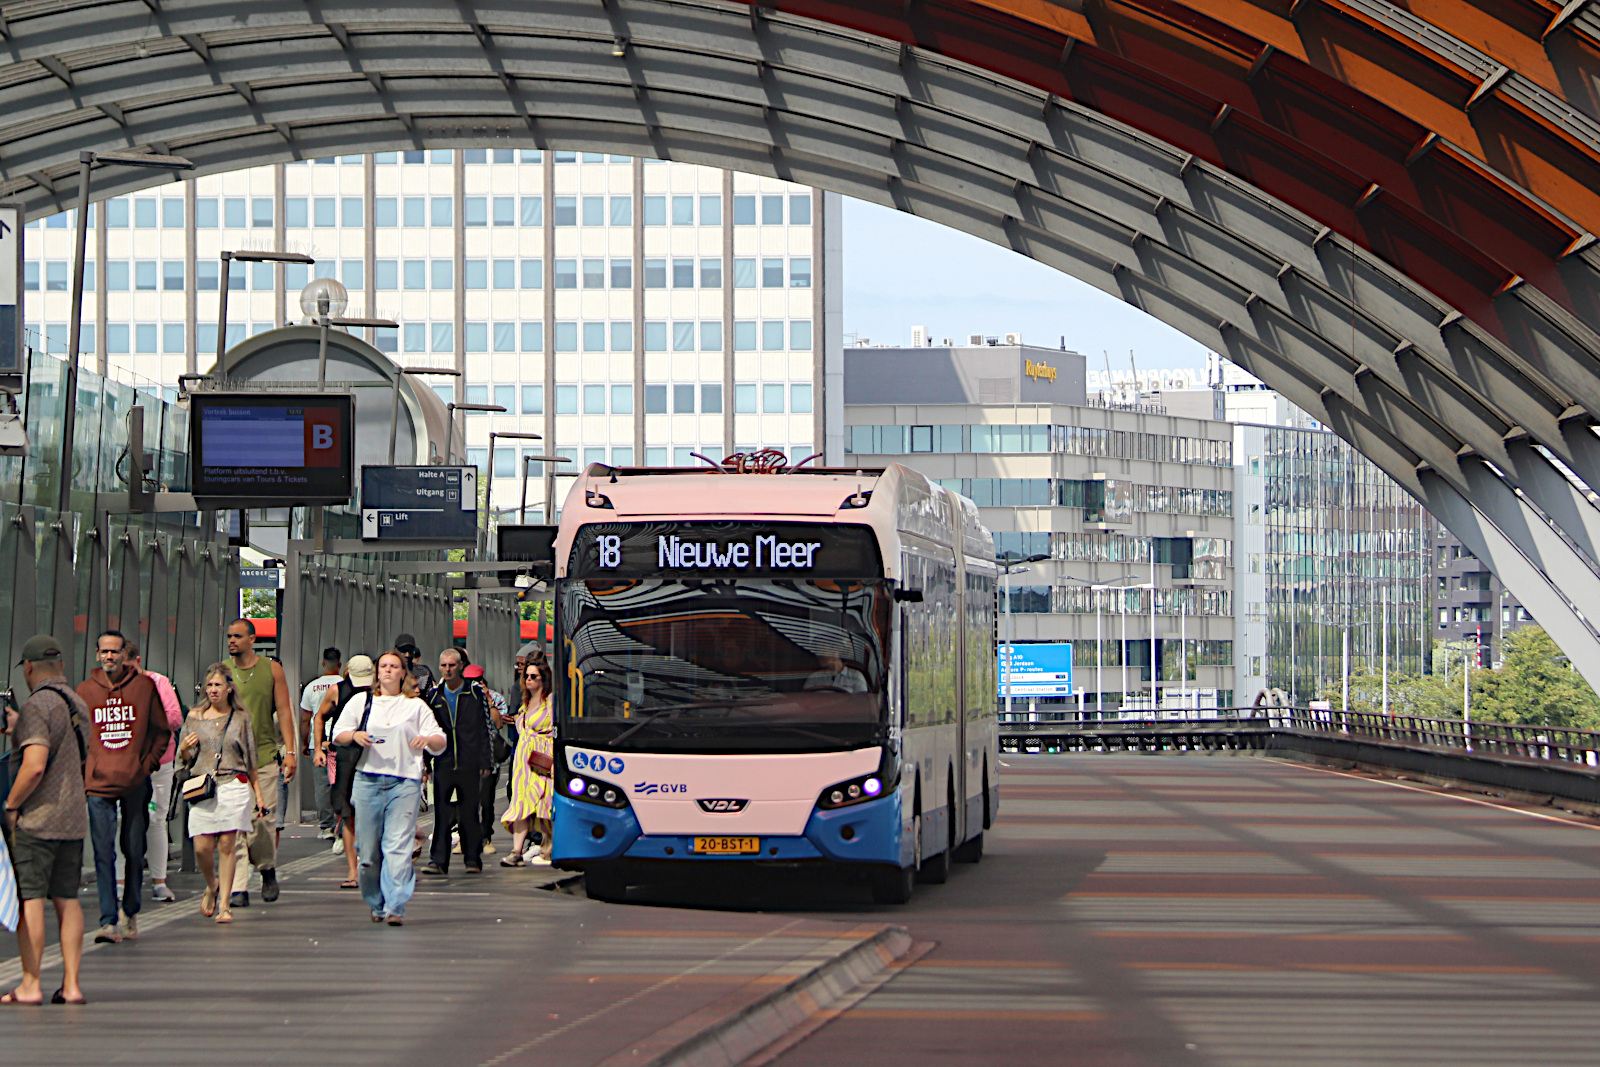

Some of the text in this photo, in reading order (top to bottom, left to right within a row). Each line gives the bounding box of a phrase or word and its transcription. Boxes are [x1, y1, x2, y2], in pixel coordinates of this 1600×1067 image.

[312, 424, 333, 449] B
[233, 467, 268, 475] uitsluitend
[416, 488, 445, 497] Uitgang
[595, 535, 821, 567] 18 Nieuwe Meer
[94, 705, 136, 724] DIESEL
[660, 784, 688, 793] GVB
[703, 800, 740, 811] VDL
[701, 838, 753, 850] 20-BST-1
